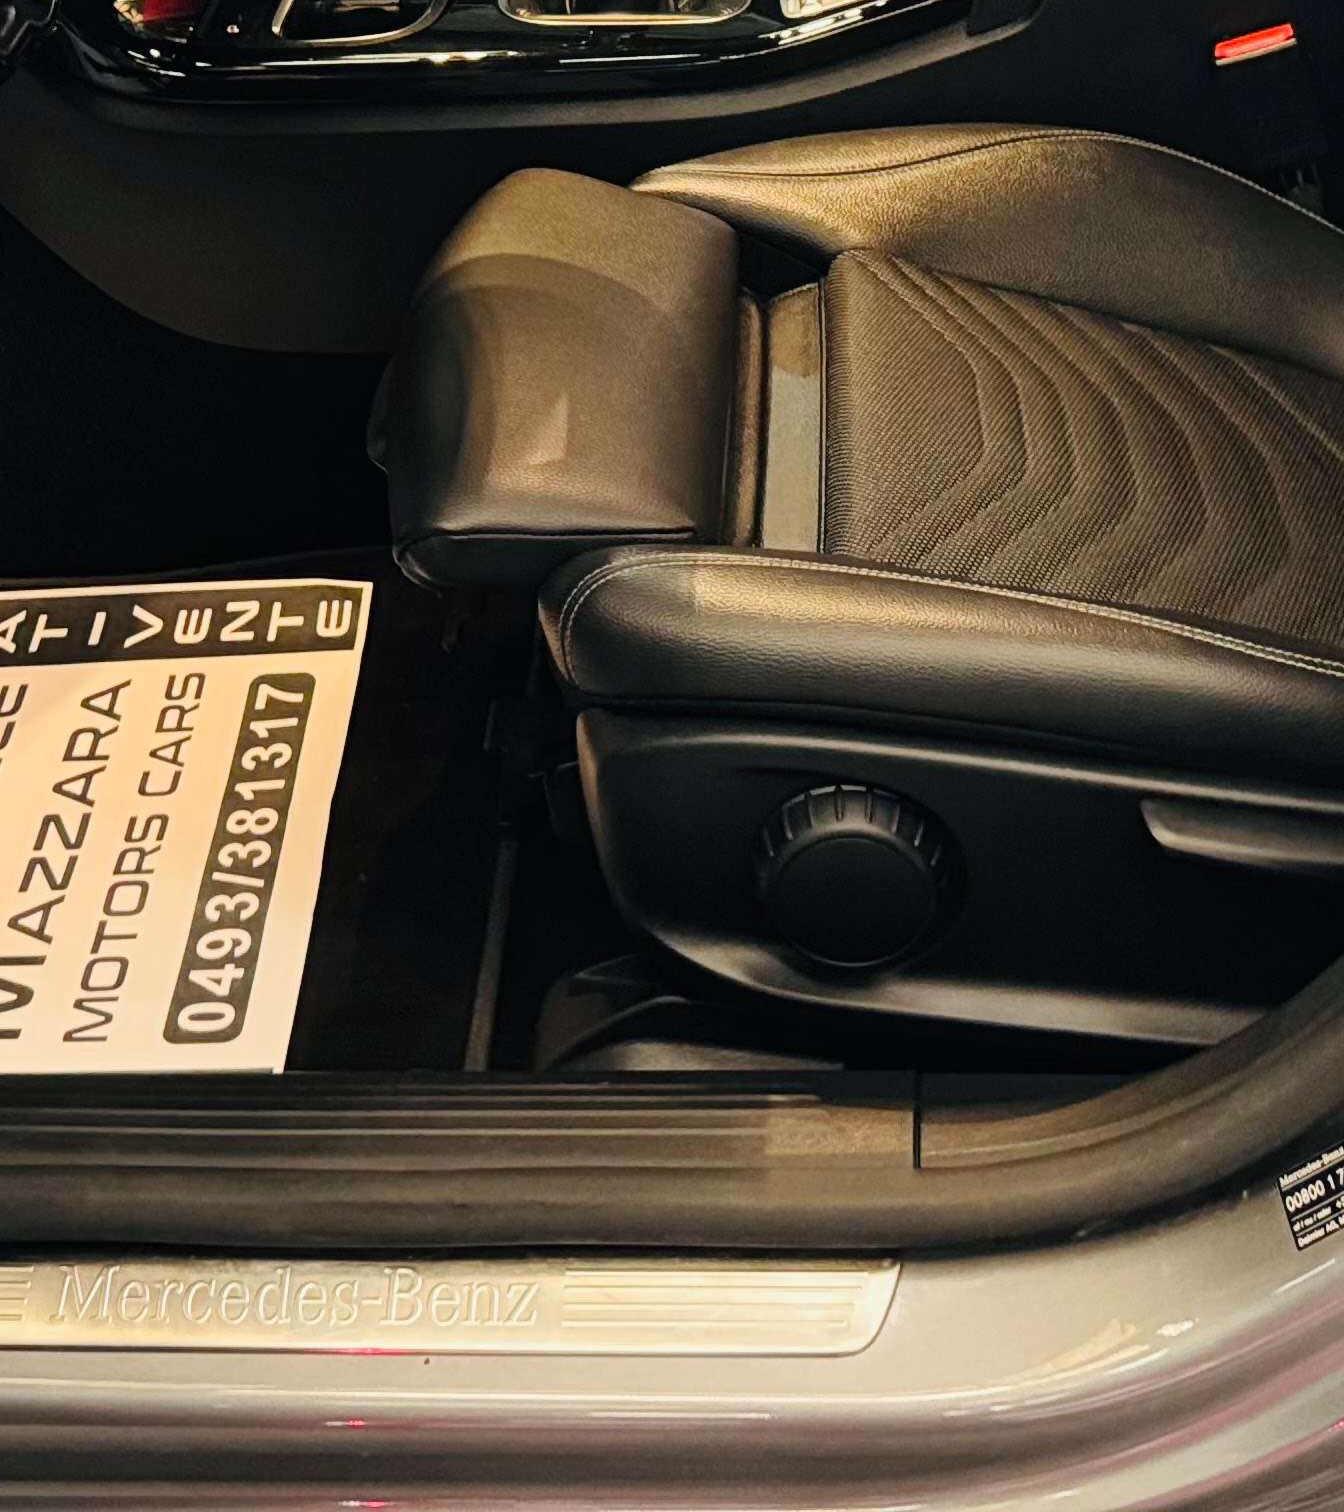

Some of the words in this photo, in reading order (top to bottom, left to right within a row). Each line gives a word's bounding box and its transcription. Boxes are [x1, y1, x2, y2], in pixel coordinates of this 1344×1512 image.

[123, 599, 353, 649] VENTE
[62, 813, 170, 1042] MOTORS
[137, 672, 207, 797] CARS
[177, 683, 306, 1033] 0493/381317
[1285, 1180, 1326, 1213] 00800
[1327, 1173, 1336, 1190] 1
[50, 1264, 541, 1328] Mercedes-Benz
